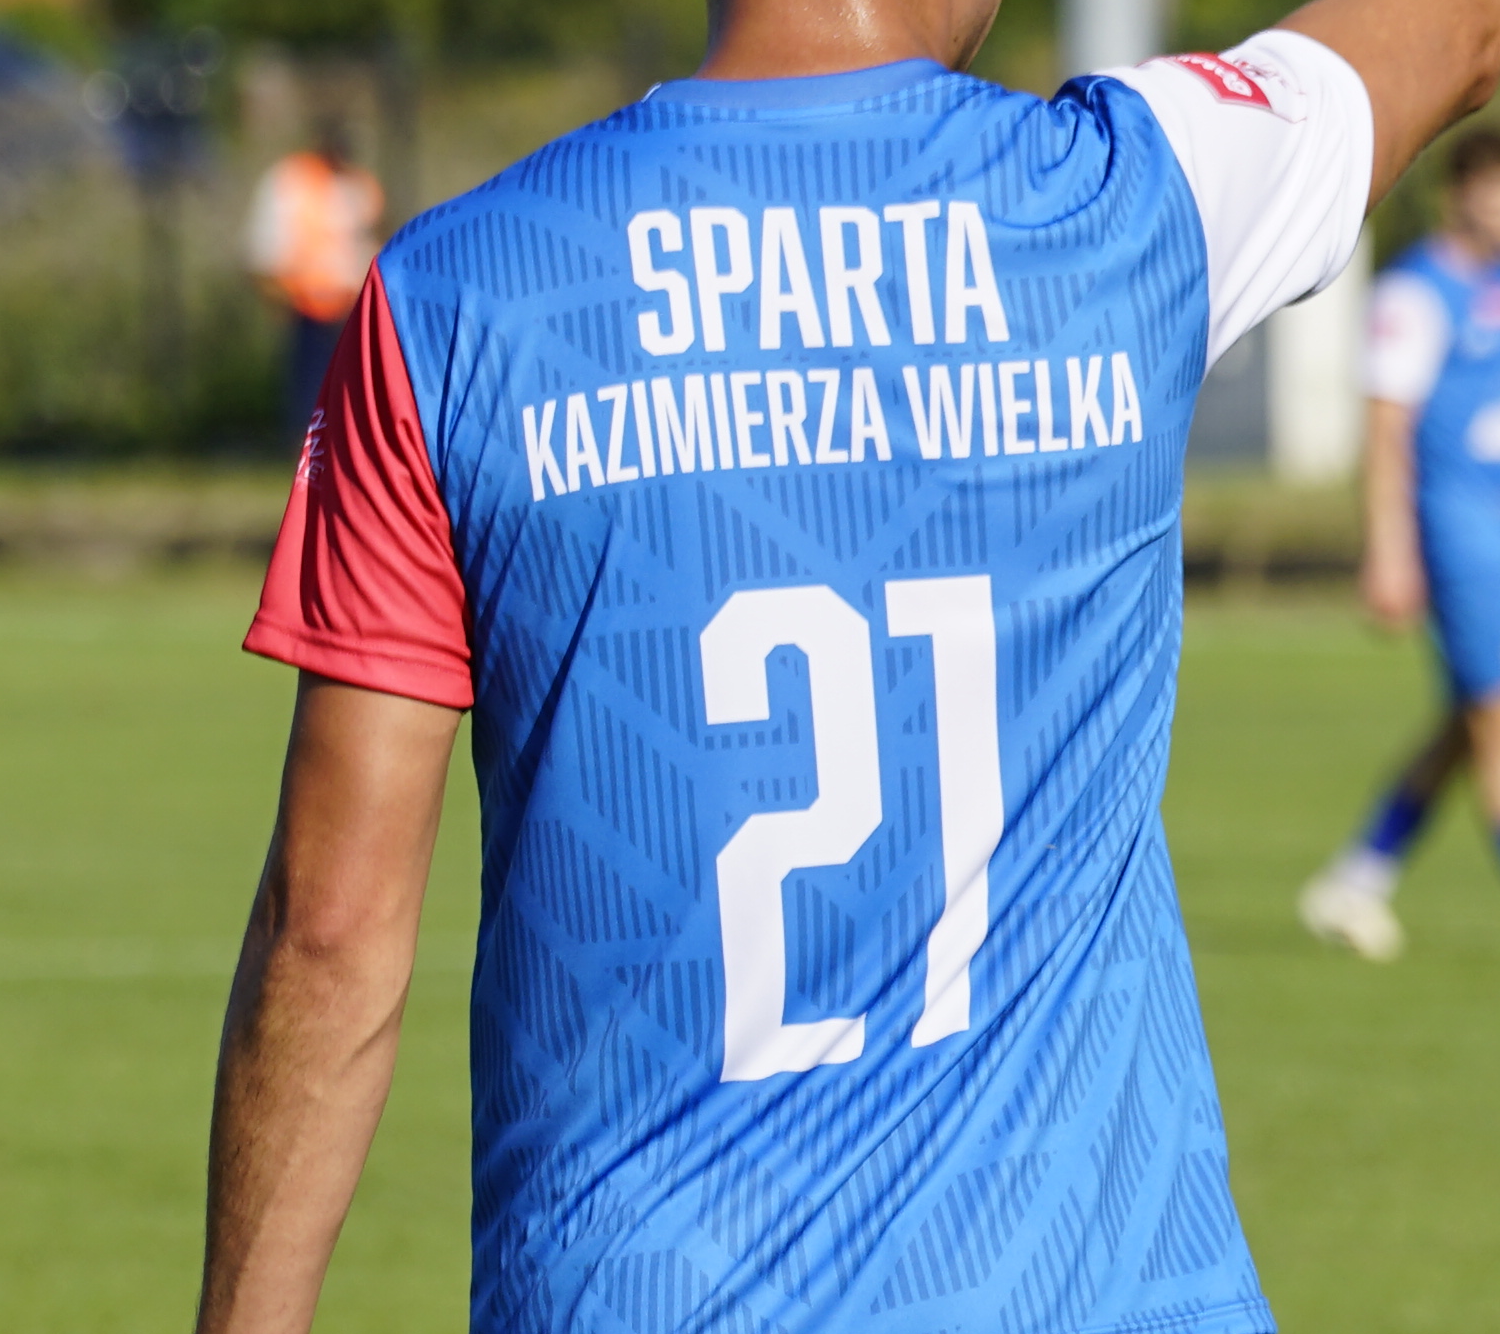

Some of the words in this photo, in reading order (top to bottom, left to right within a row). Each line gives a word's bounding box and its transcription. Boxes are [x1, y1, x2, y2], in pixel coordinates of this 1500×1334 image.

[628, 200, 1010, 357] SPARTA
[522, 368, 892, 502] KAZIMIERZA
[902, 352, 1143, 460] WIELKA
[700, 575, 1004, 1082] 21
